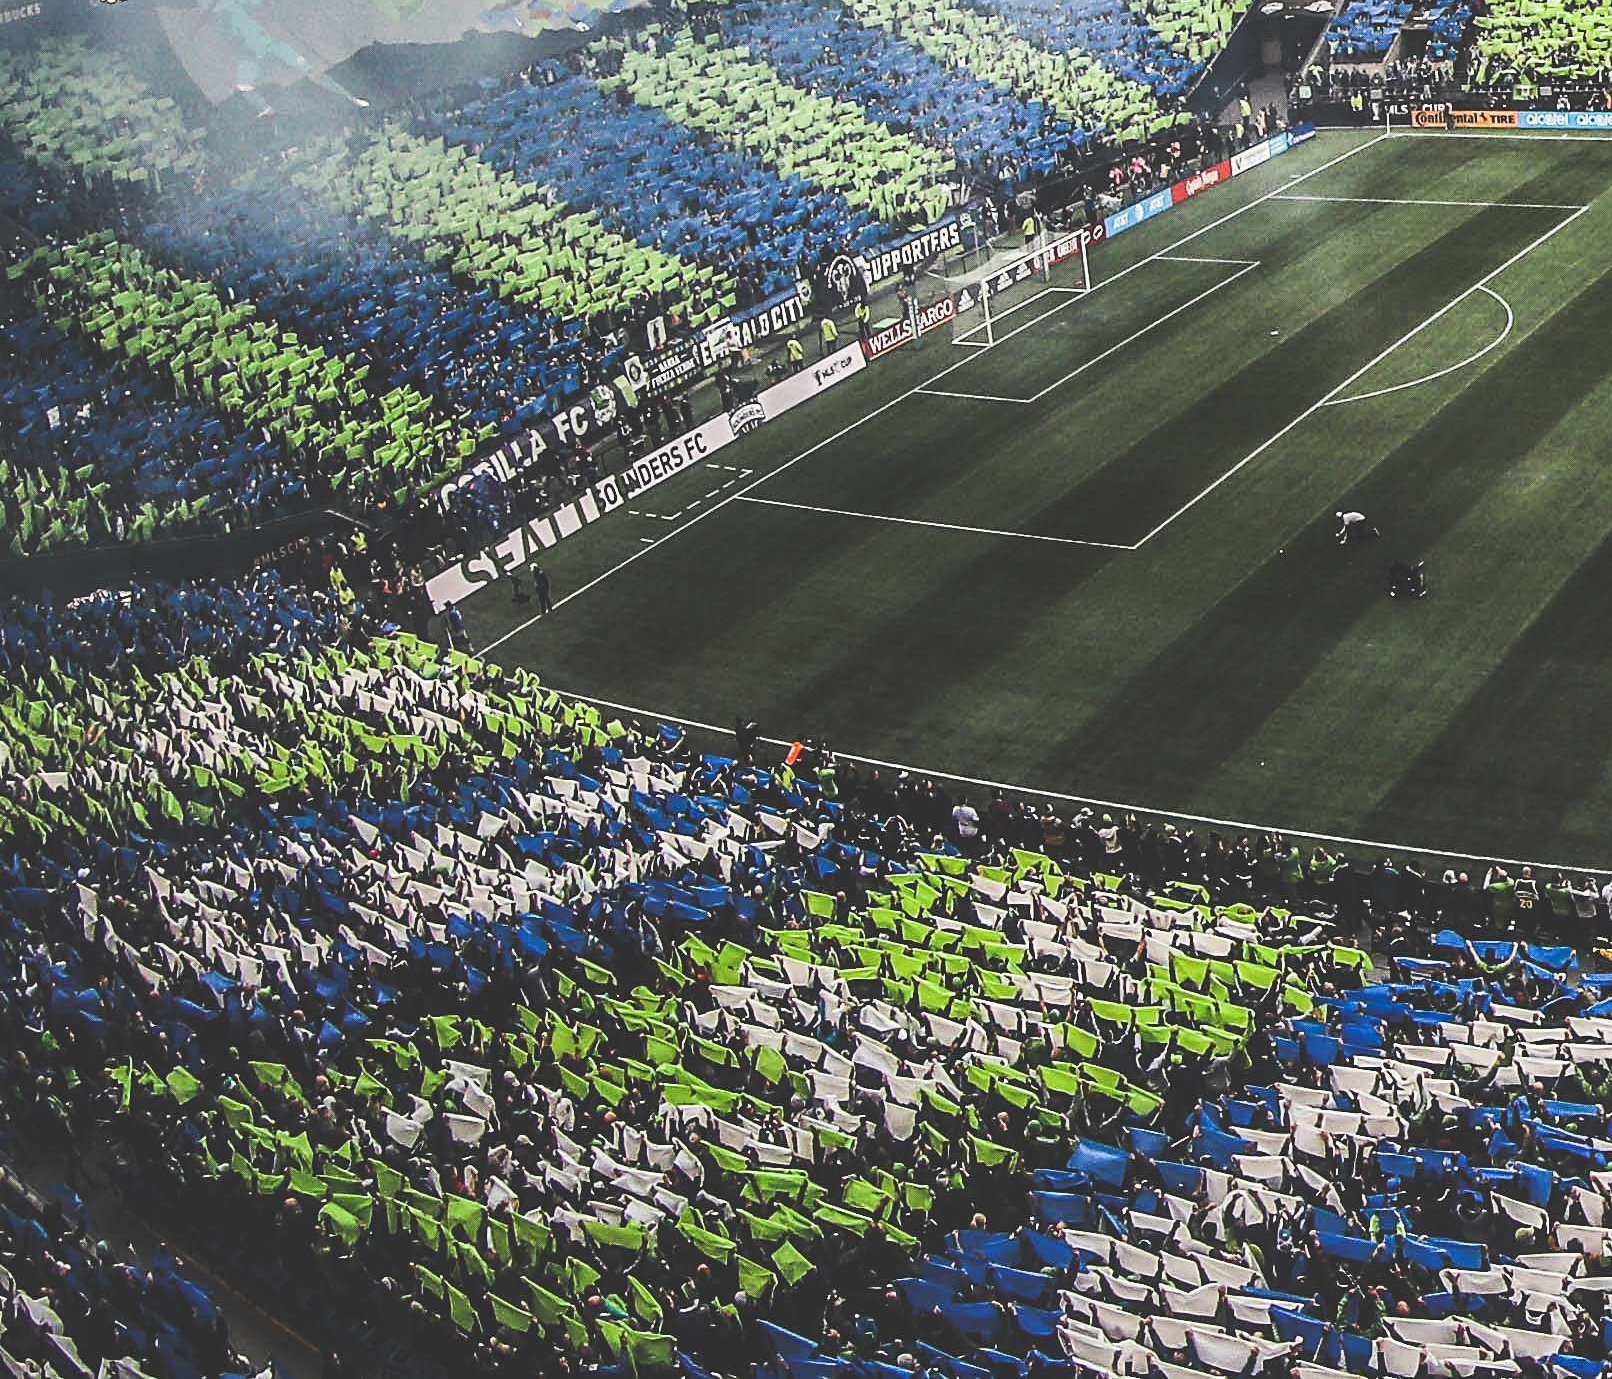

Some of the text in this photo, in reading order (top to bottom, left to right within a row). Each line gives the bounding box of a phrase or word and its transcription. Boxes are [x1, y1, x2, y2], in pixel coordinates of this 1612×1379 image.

[1490, 114, 1516, 125] TIRE
[862, 222, 961, 285] SUPPORTERS
[773, 297, 805, 331] CITY
[868, 319, 913, 354] WELLS
[552, 406, 589, 445] FC
[686, 432, 708, 459] FC
